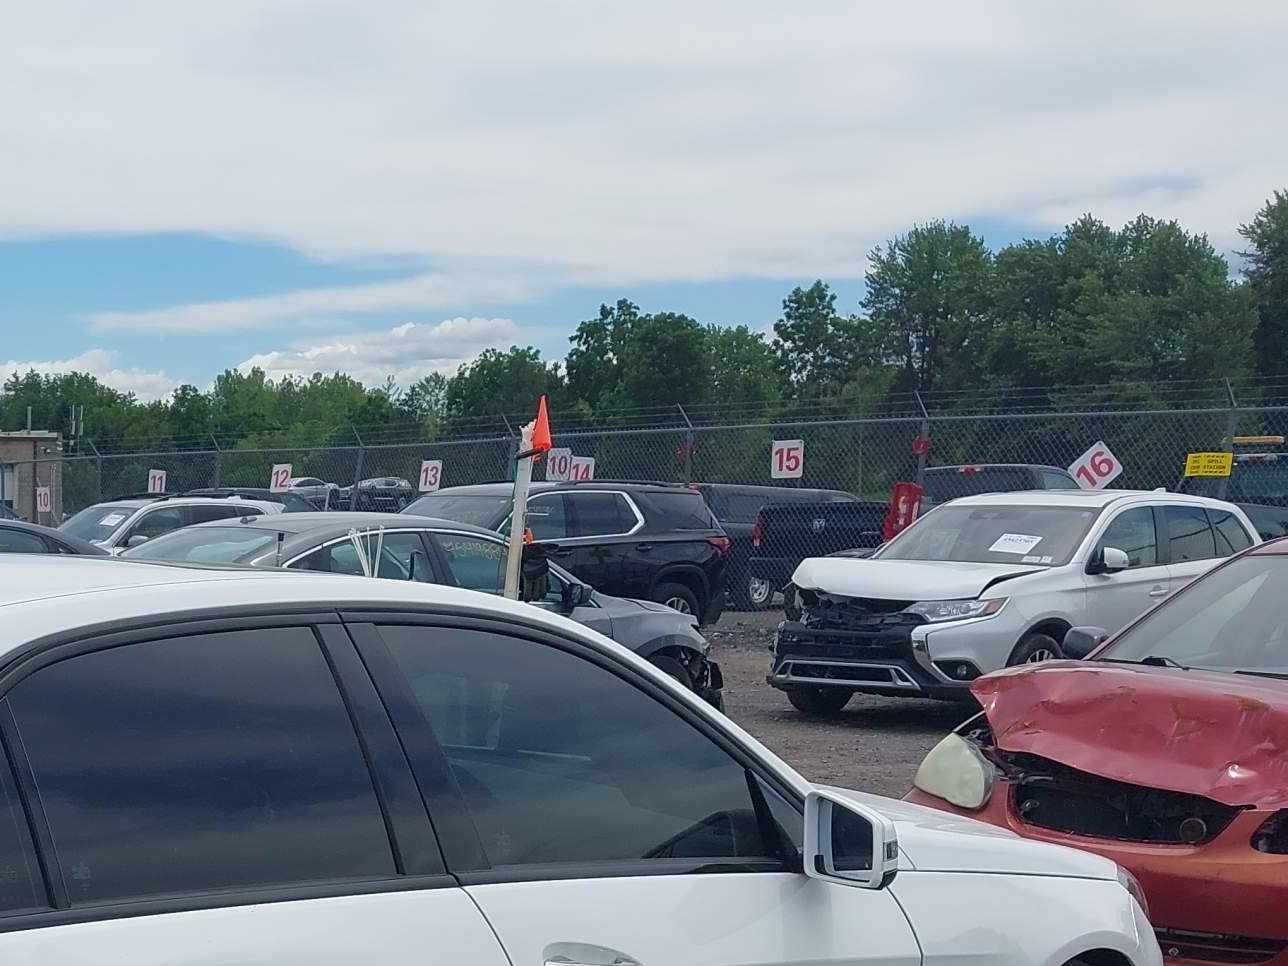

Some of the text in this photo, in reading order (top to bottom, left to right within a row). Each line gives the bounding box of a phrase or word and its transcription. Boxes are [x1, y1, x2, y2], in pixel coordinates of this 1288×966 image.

[549, 456, 568, 476] 10
[774, 447, 800, 472] 15
[1075, 450, 1115, 488] 16
[273, 469, 288, 488] 12
[421, 467, 439, 487] 13
[572, 463, 590, 480] 14
[150, 475, 164, 493] 11
[38, 492, 50, 507] 10
